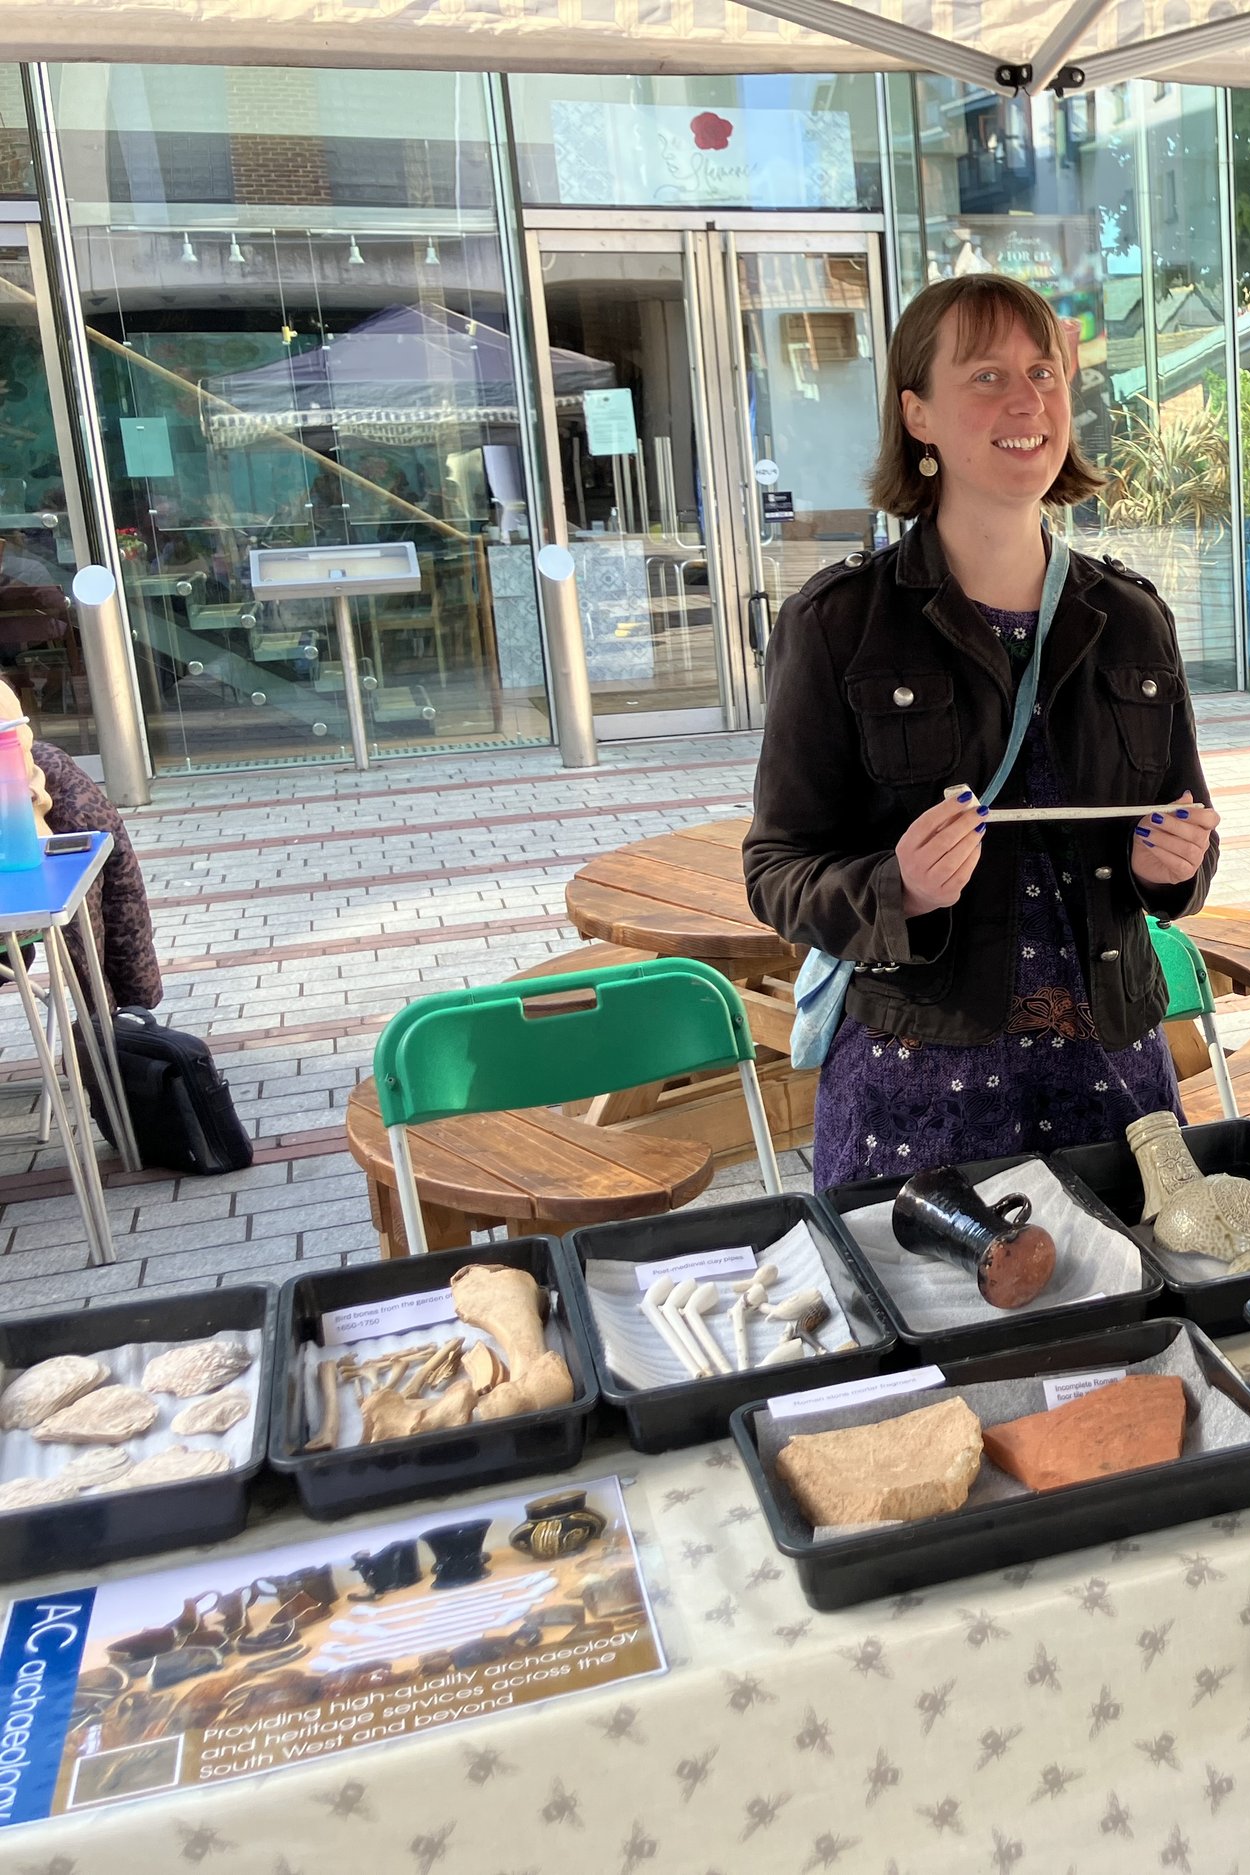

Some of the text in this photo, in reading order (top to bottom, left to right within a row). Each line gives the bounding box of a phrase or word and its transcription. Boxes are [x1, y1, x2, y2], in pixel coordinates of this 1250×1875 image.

[652, 1254, 744, 1275] Post-medieval clay pipes
[335, 1313, 352, 1323] Bird
[353, 1308, 379, 1319] bones
[380, 1303, 400, 1313] from
[401, 1300, 415, 1308] the
[416, 1295, 443, 1306] garden
[336, 1318, 380, 1332] 1650-1750
[793, 1395, 825, 1406] Roman
[851, 1385, 878, 1396] mortar
[880, 1377, 917, 1391] fragment
[1055, 1381, 1093, 1392] Incomplete
[1093, 1377, 1118, 1387] Roman
[1056, 1392, 1072, 1401] floor
[1073, 1390, 1084, 1398] tile
[203, 1629, 639, 1743] Providing high-quality archaeology
[0, 1604, 83, 1820] AC archaeolo
[201, 1651, 617, 1760] and heritage services across the
[199, 1691, 514, 1780] South West and beyond
